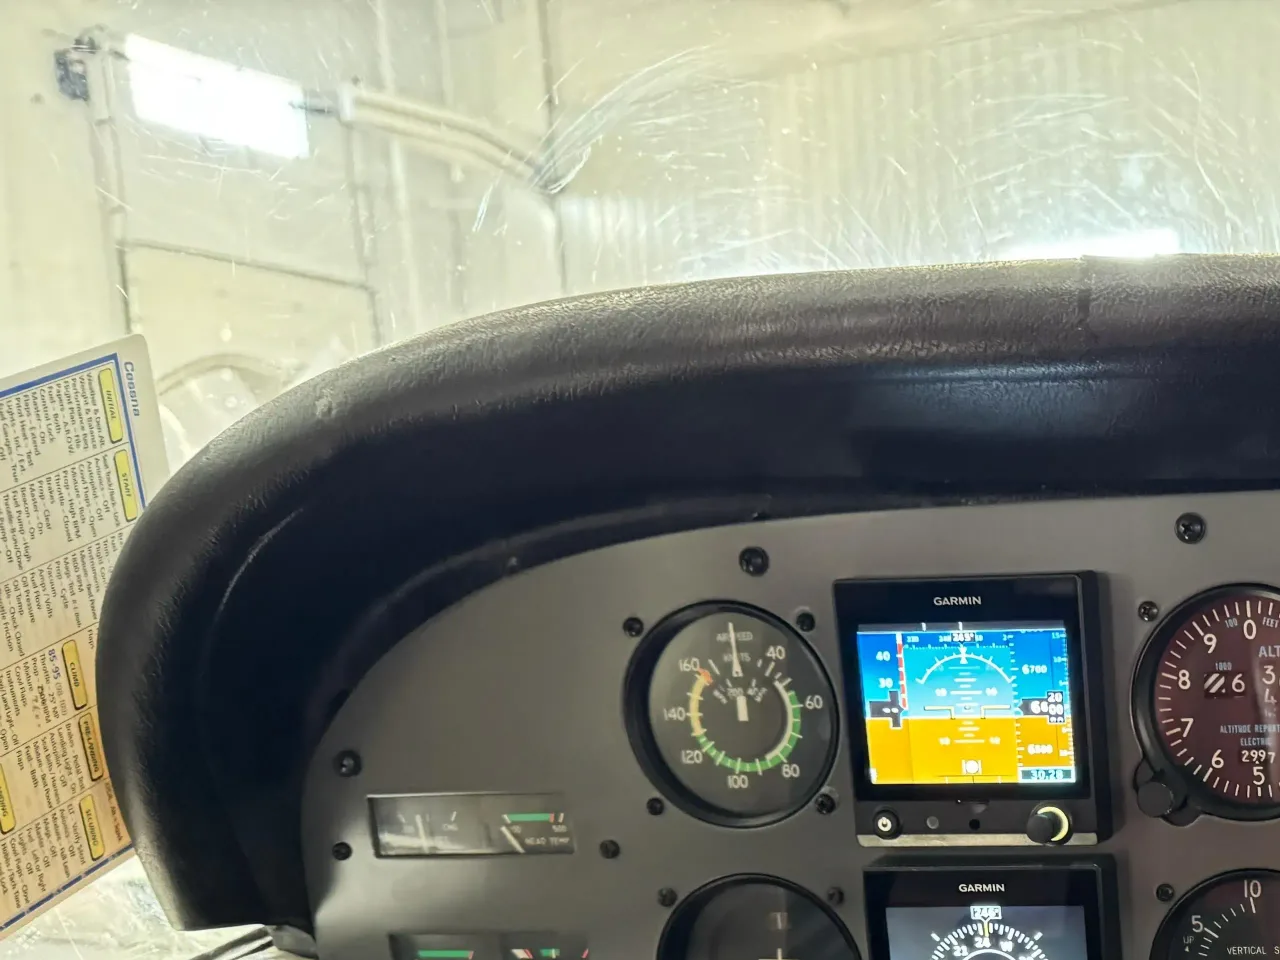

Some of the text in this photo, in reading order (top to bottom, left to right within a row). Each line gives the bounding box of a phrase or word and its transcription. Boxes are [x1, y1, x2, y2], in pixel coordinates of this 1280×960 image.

[106, 390, 117, 421] INITIAL
[46, 477, 54, 504] Brakes
[121, 473, 131, 497] START
[47, 565, 56, 597] Vacuum
[23, 587, 35, 623] Pressure
[933, 596, 982, 606] GARMIN
[1243, 620, 1257, 639] 0
[1203, 633, 1217, 653] 9
[766, 646, 785, 659] 40
[678, 659, 700, 672] 160
[1022, 664, 1047, 675] 6700
[23, 661, 33, 691] Mixture
[6, 670, 21, 717] Instruments
[19, 686, 28, 707] Flaps
[805, 696, 823, 709] 60
[664, 708, 686, 721] 140
[1181, 718, 1194, 737] 7
[1241, 750, 1276, 763] 2997
[782, 764, 800, 777] 80
[1030, 769, 1063, 780] 30.28
[727, 776, 749, 788] 100
[959, 883, 1005, 893] GARMIN
[1244, 880, 1261, 898] 10
[1227, 947, 1266, 955] VERTICAL
